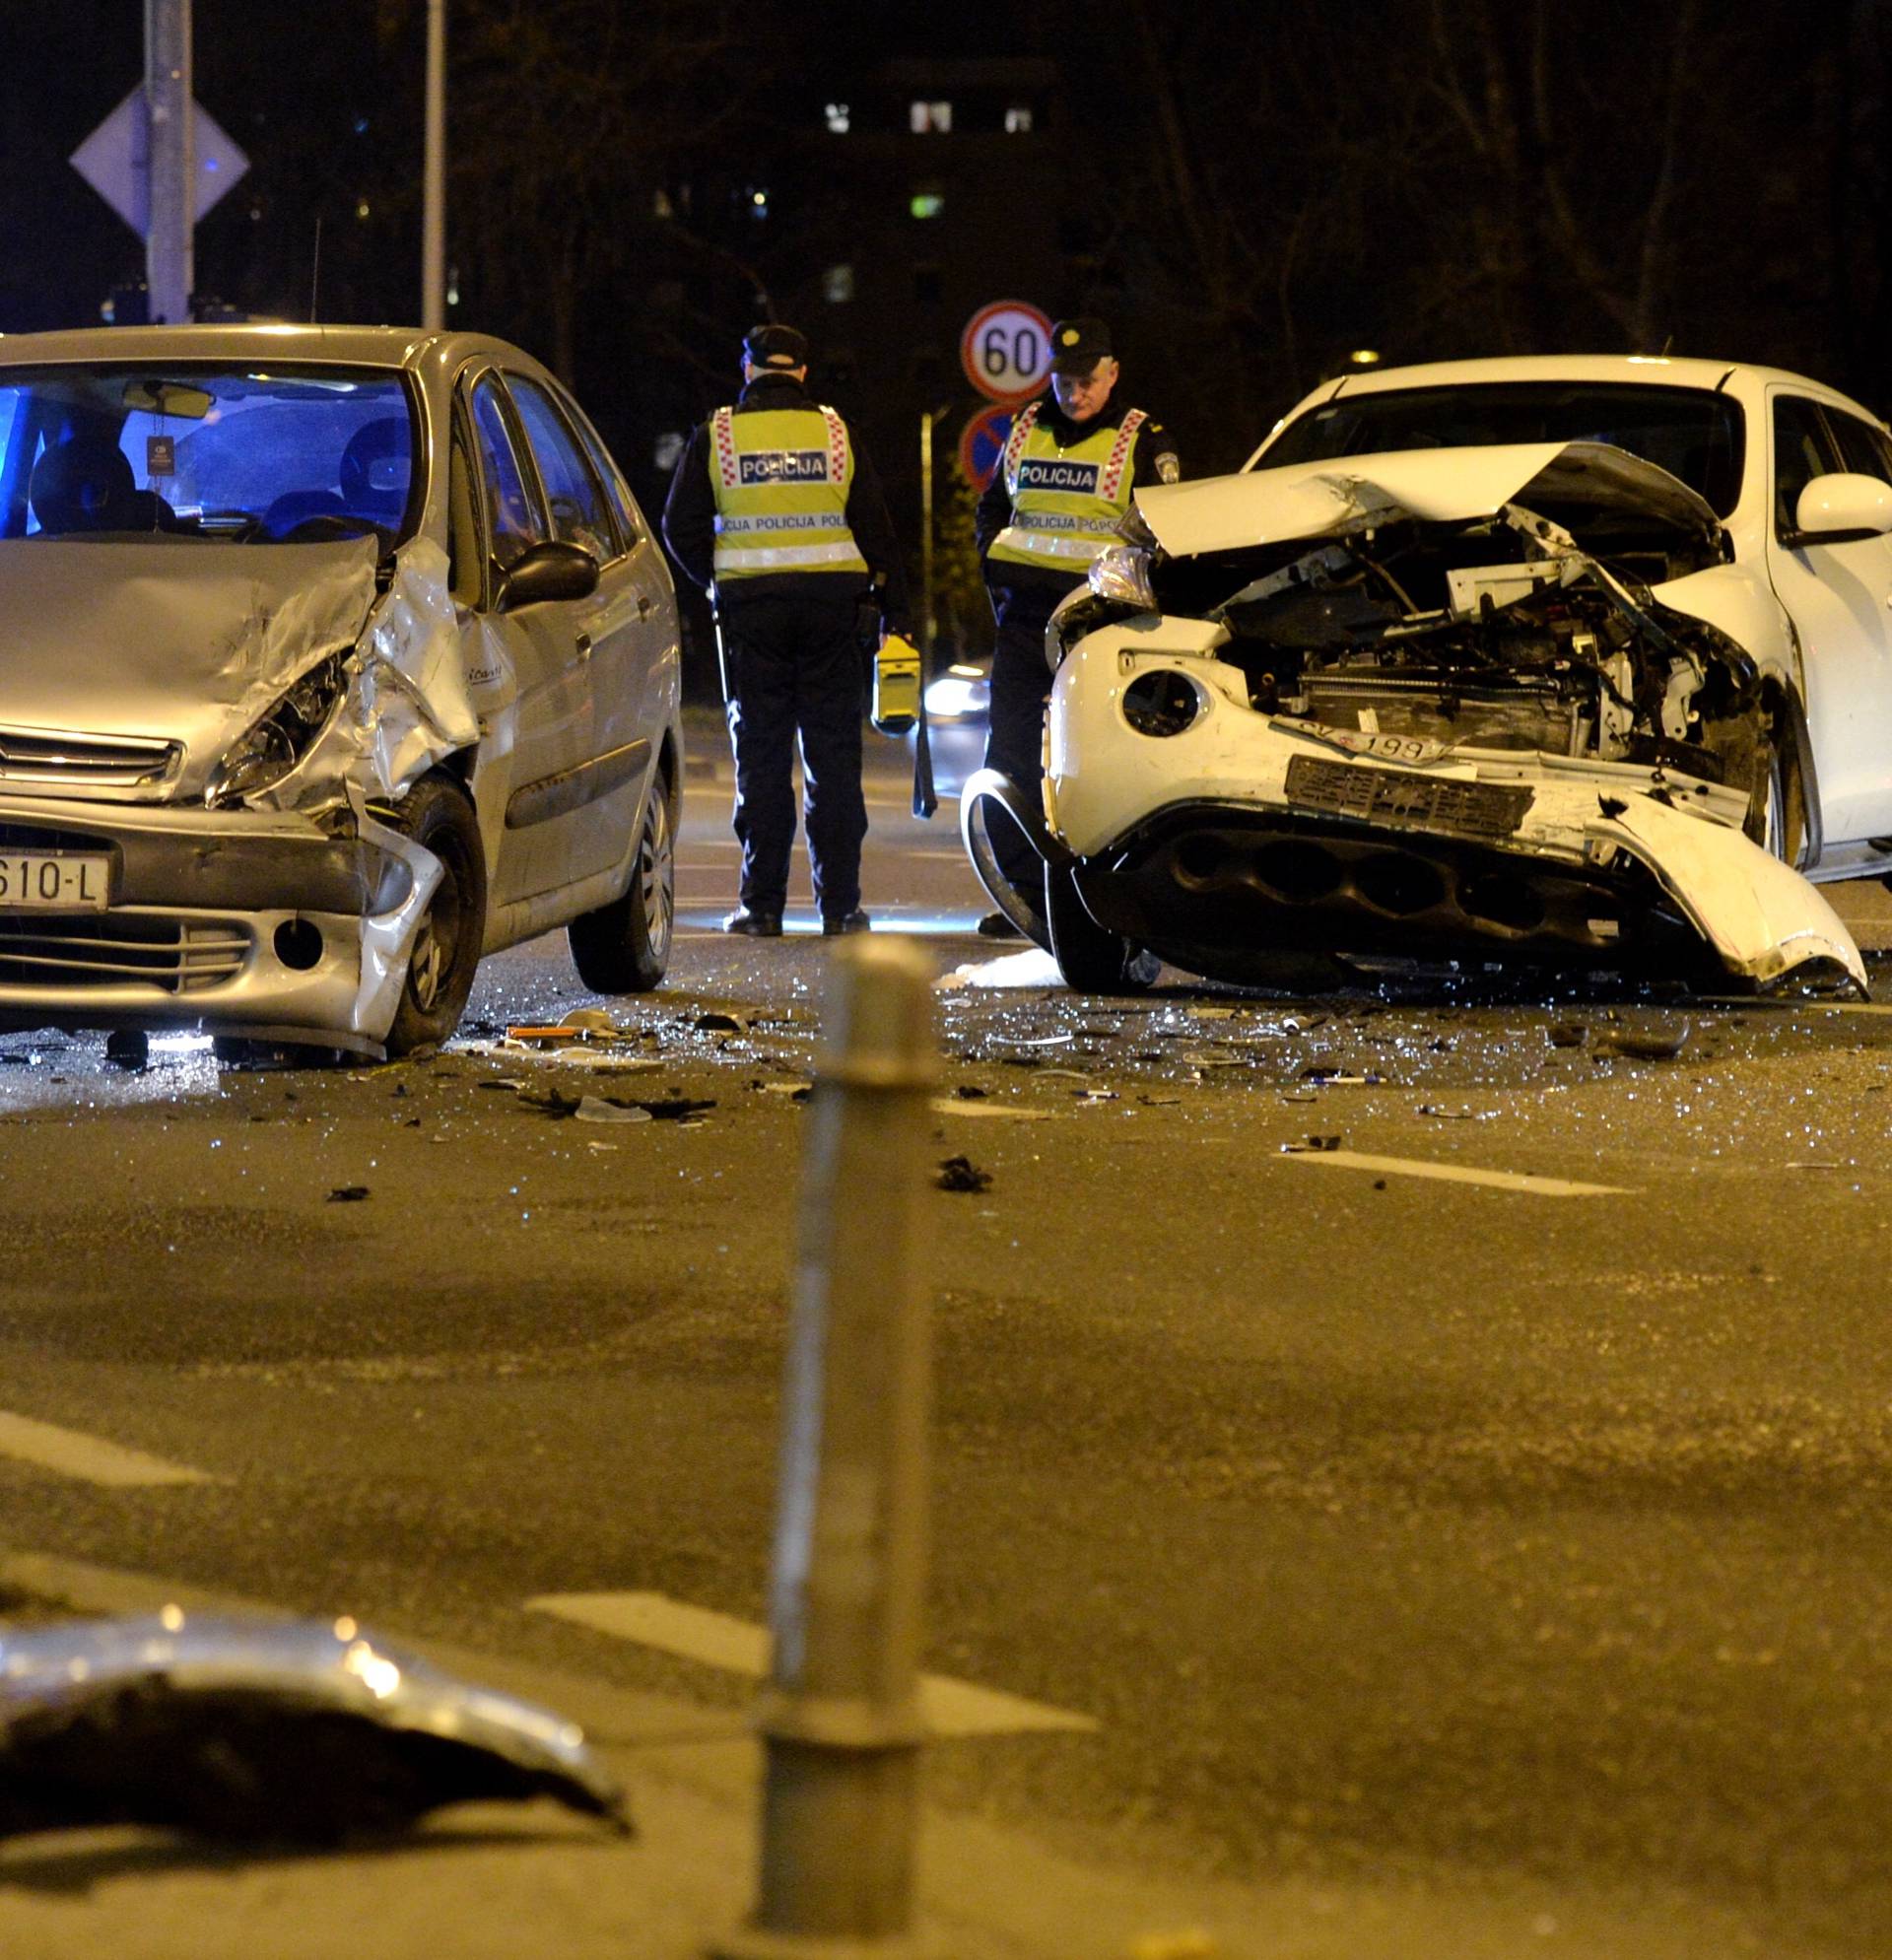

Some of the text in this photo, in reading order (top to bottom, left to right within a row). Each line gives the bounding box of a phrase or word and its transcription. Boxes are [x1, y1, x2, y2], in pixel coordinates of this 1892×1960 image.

[985, 328, 1037, 375] 60
[743, 458, 824, 478] POLICIJA
[1020, 466, 1093, 486] POLICIJA
[756, 516, 815, 532] POLICIJA
[1025, 514, 1076, 529] POLICIJA
